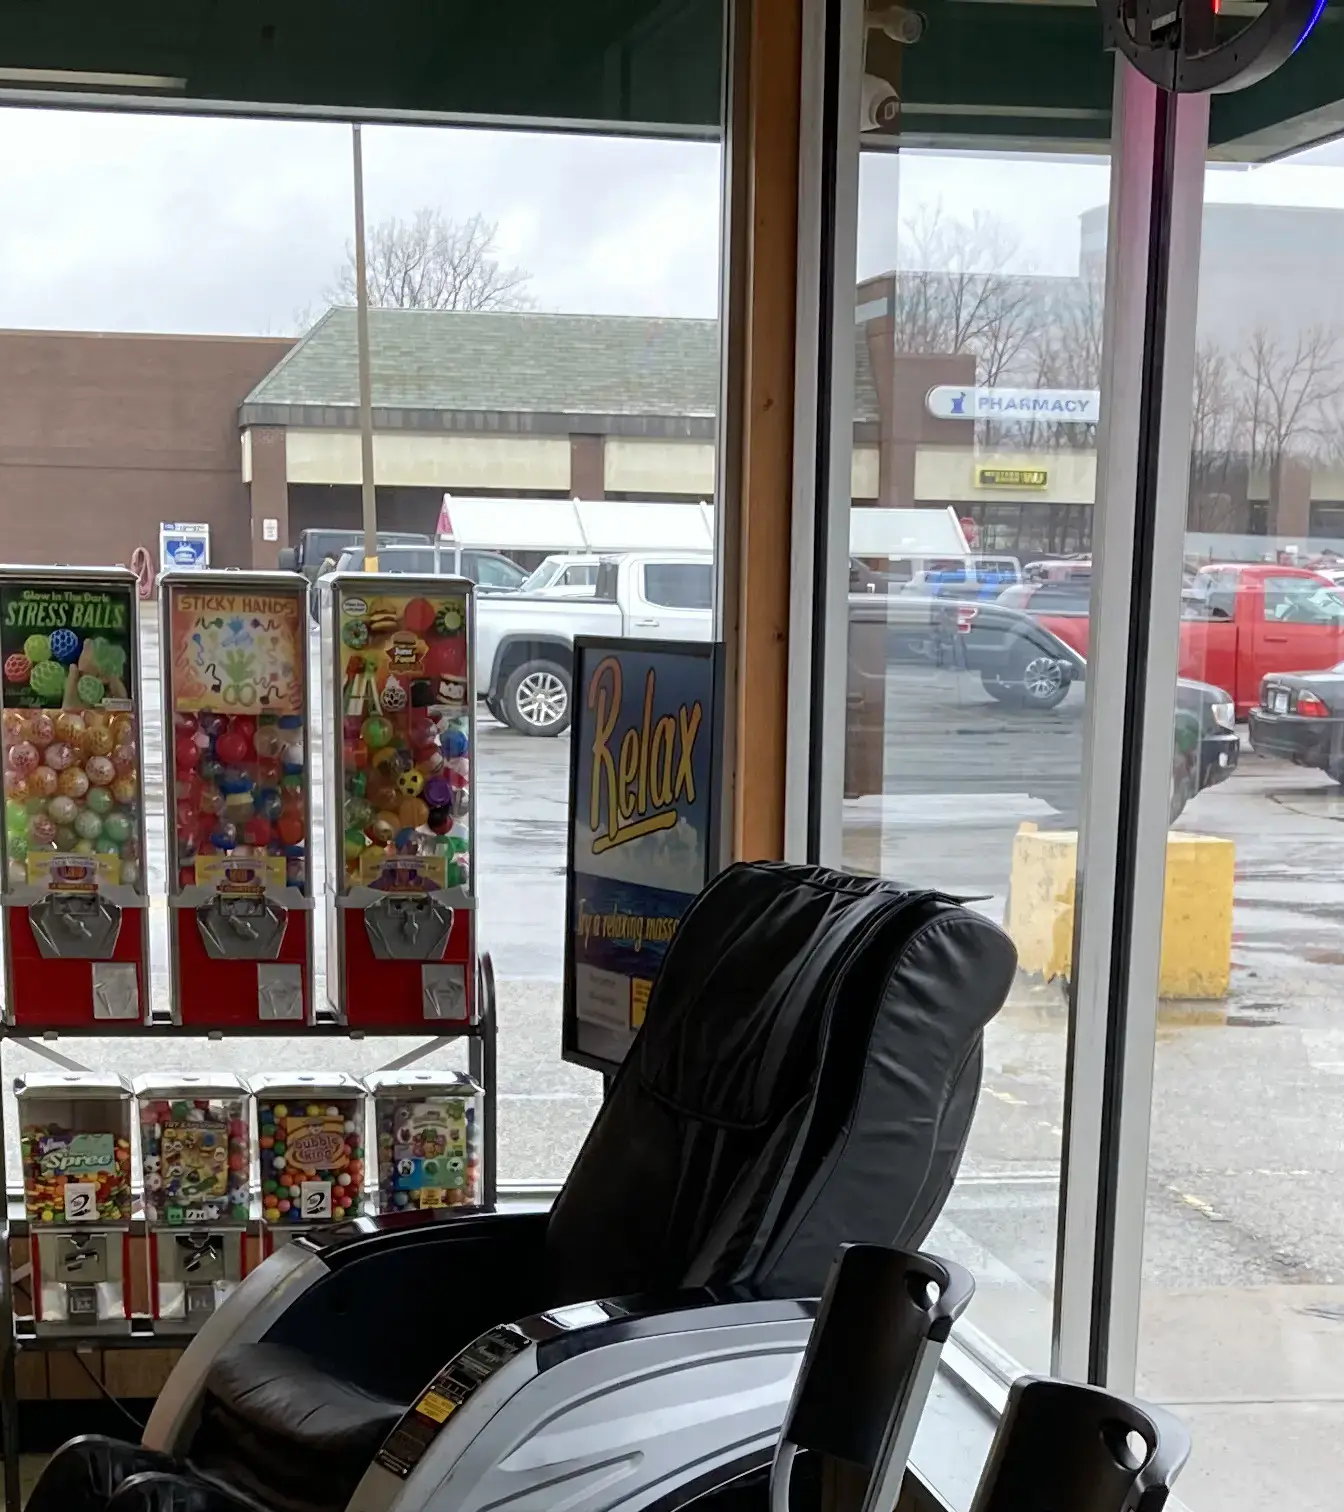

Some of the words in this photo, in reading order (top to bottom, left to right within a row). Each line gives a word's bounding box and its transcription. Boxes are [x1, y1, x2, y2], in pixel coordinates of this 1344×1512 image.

[978, 397, 1090, 412] PHARMACY
[23, 590, 51, 601] Glow
[52, 591, 62, 601] In
[64, 591, 82, 602] The
[84, 592, 110, 603] Dark
[181, 596, 236, 611] STICKY
[242, 598, 297, 615] HANDS
[5, 601, 69, 627] STRESS
[71, 603, 126, 629] BALLS
[588, 655, 703, 841] Relax
[593, 913, 601, 937] a
[602, 902, 645, 952] relaxing
[295, 1135, 339, 1149] bubble
[46, 1152, 113, 1171] Spree
[299, 1147, 334, 1160] king
